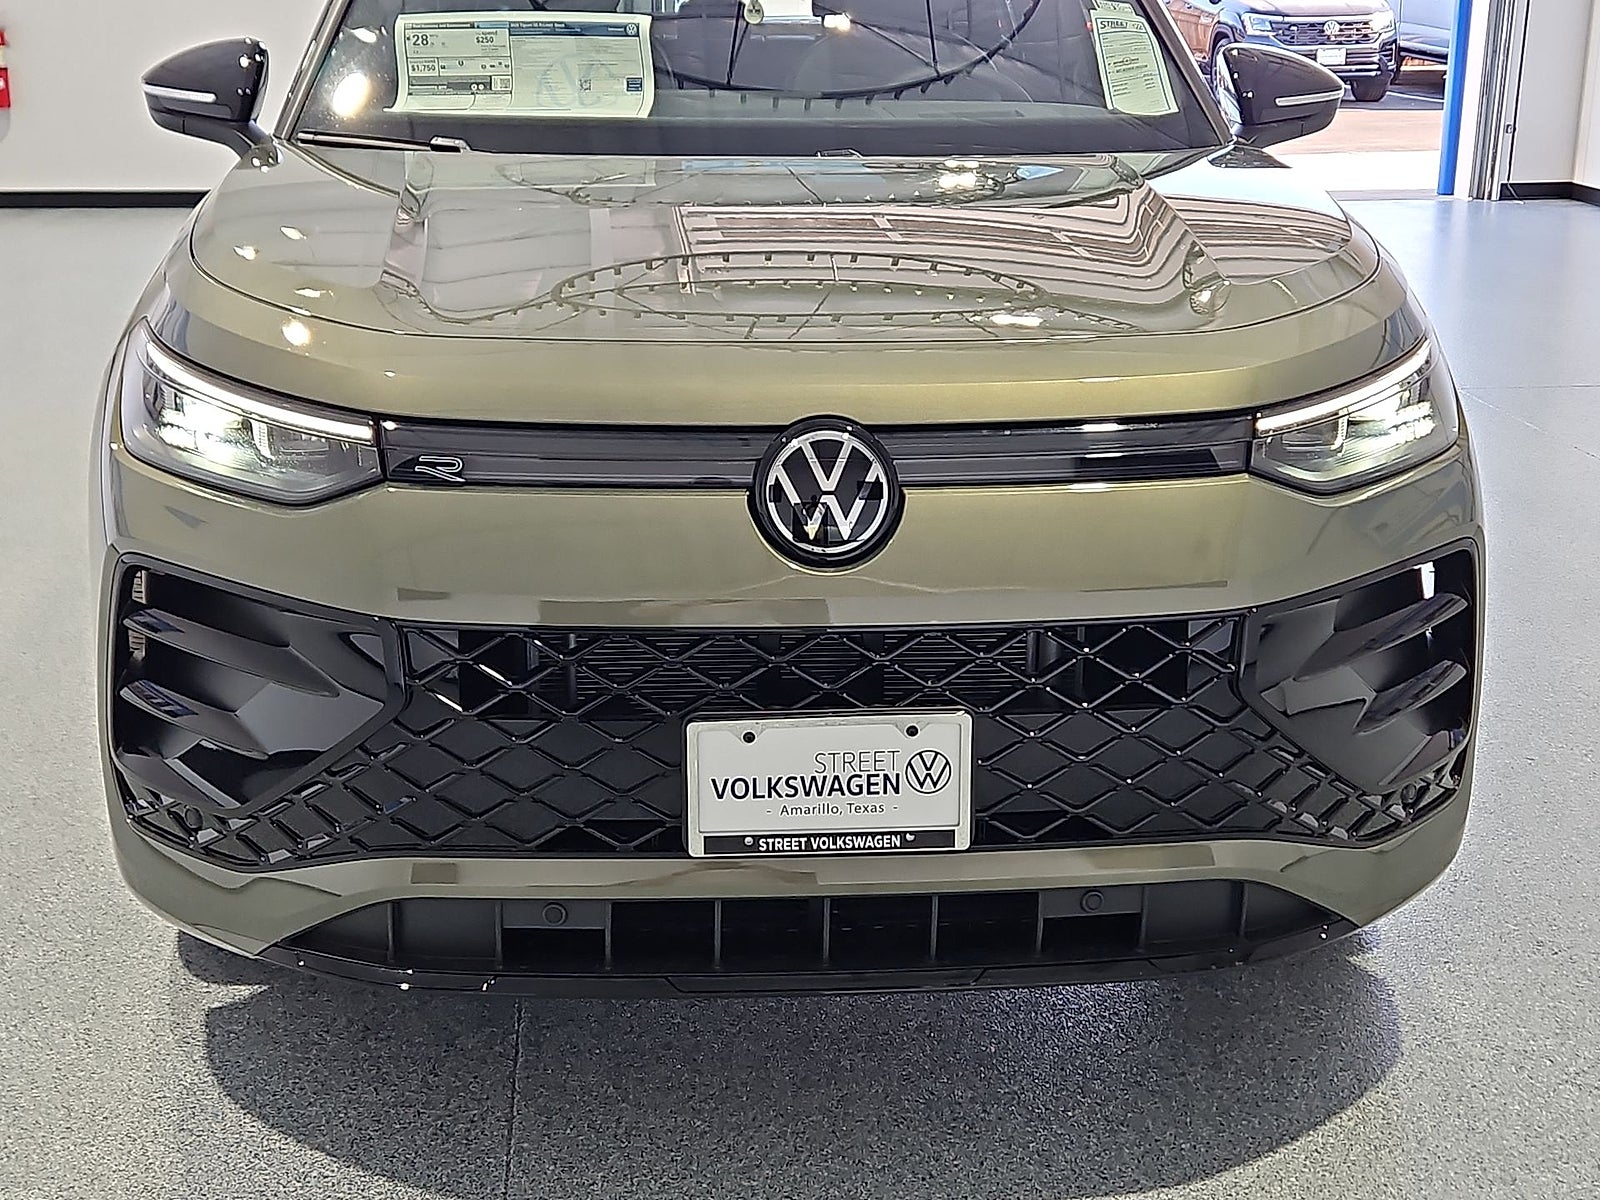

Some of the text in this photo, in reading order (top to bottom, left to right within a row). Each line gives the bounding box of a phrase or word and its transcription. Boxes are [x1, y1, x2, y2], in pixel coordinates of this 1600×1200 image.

[412, 34, 429, 46] 28
[475, 36, 494, 44] $250
[411, 64, 436, 72] $1,750
[415, 456, 466, 482] R
[814, 750, 900, 774] STREET
[711, 773, 901, 800] VOLKSWAGEN
[780, 803, 885, 817] Amarillo, Texas
[759, 834, 901, 851] STREET VOLKSWAGEN
